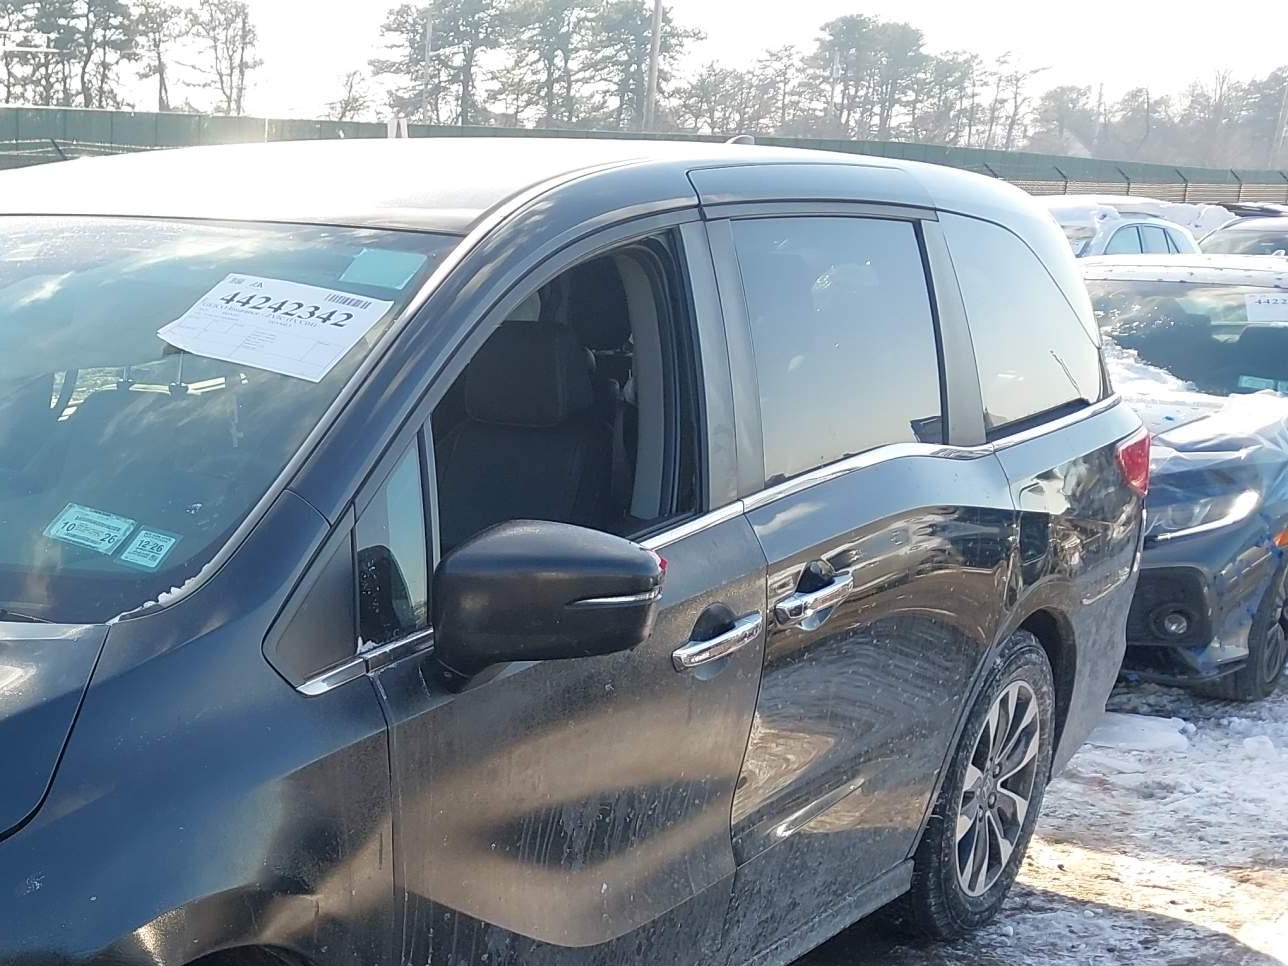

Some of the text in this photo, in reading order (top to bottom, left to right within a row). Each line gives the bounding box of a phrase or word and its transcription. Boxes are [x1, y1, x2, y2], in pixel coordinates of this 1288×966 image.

[219, 291, 354, 328] 44242342
[61, 521, 76, 532] 10
[100, 532, 118, 544] 26
